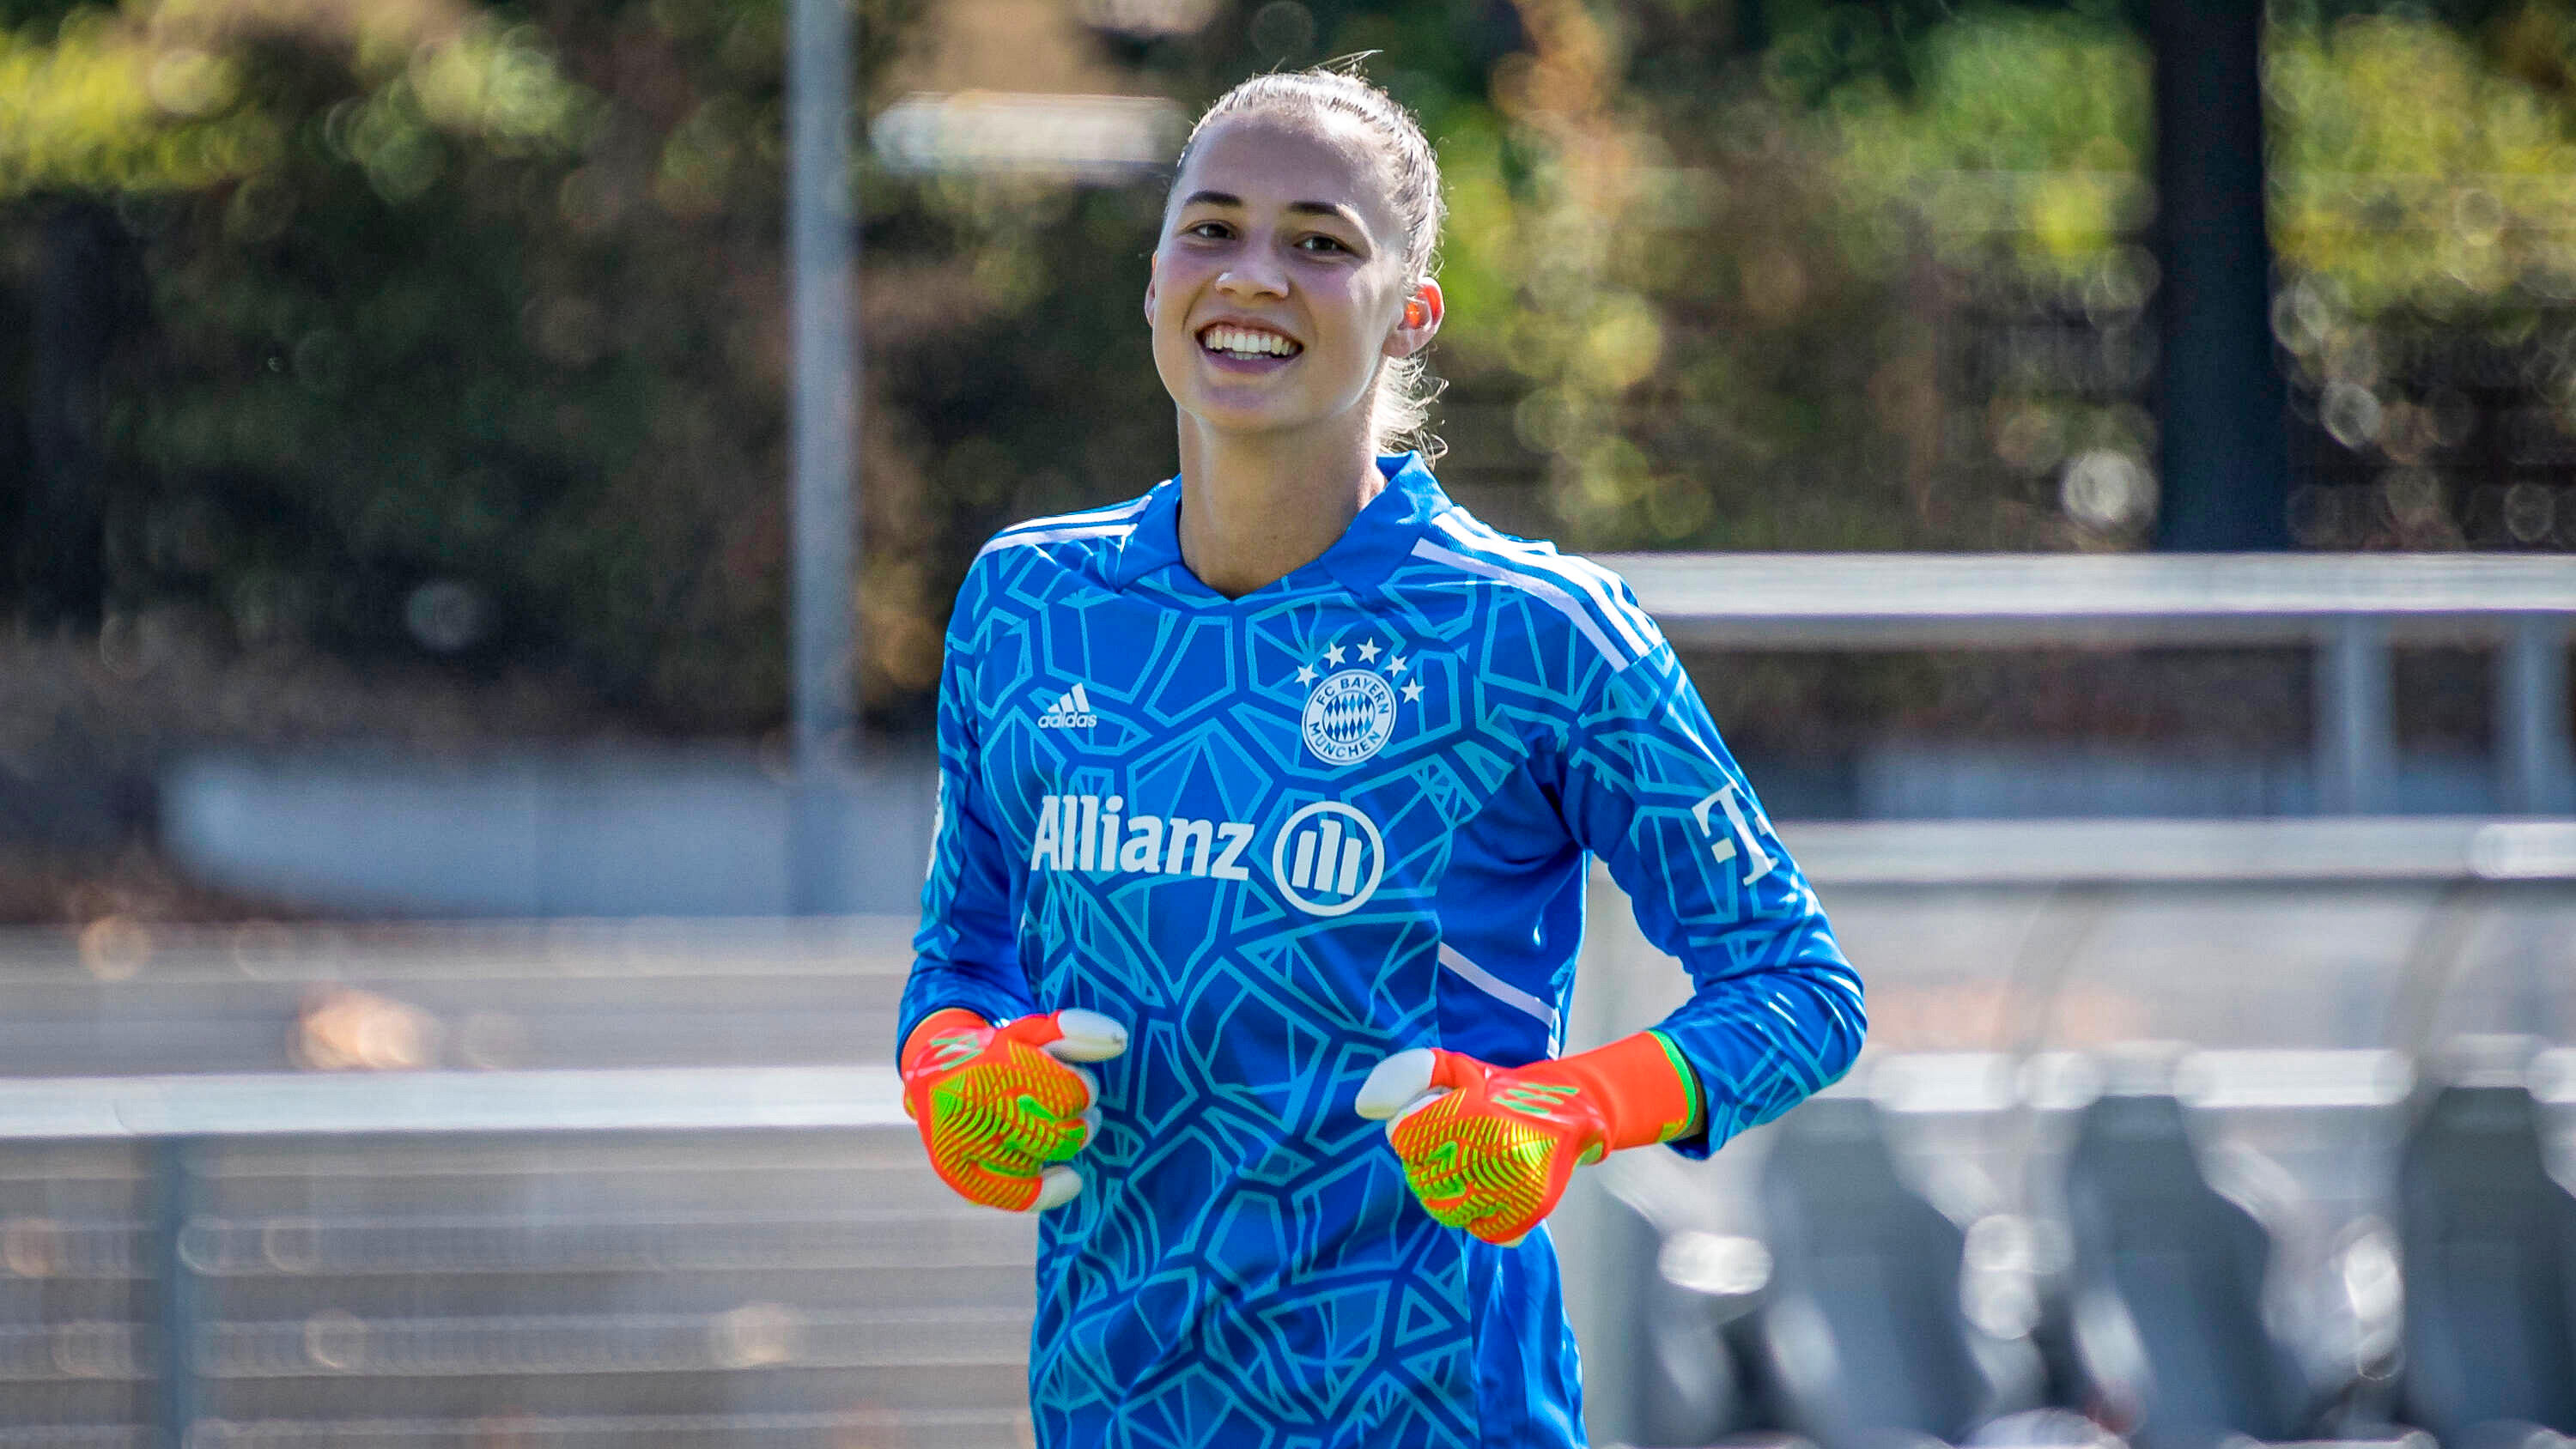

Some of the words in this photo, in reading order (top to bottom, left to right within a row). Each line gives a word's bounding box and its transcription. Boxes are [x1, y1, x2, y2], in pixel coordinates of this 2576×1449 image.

[1316, 686, 1335, 706] FC
[1340, 676, 1389, 714] BAYERN
[1037, 711, 1097, 729] adidas
[1030, 794, 1255, 882] Allianz
